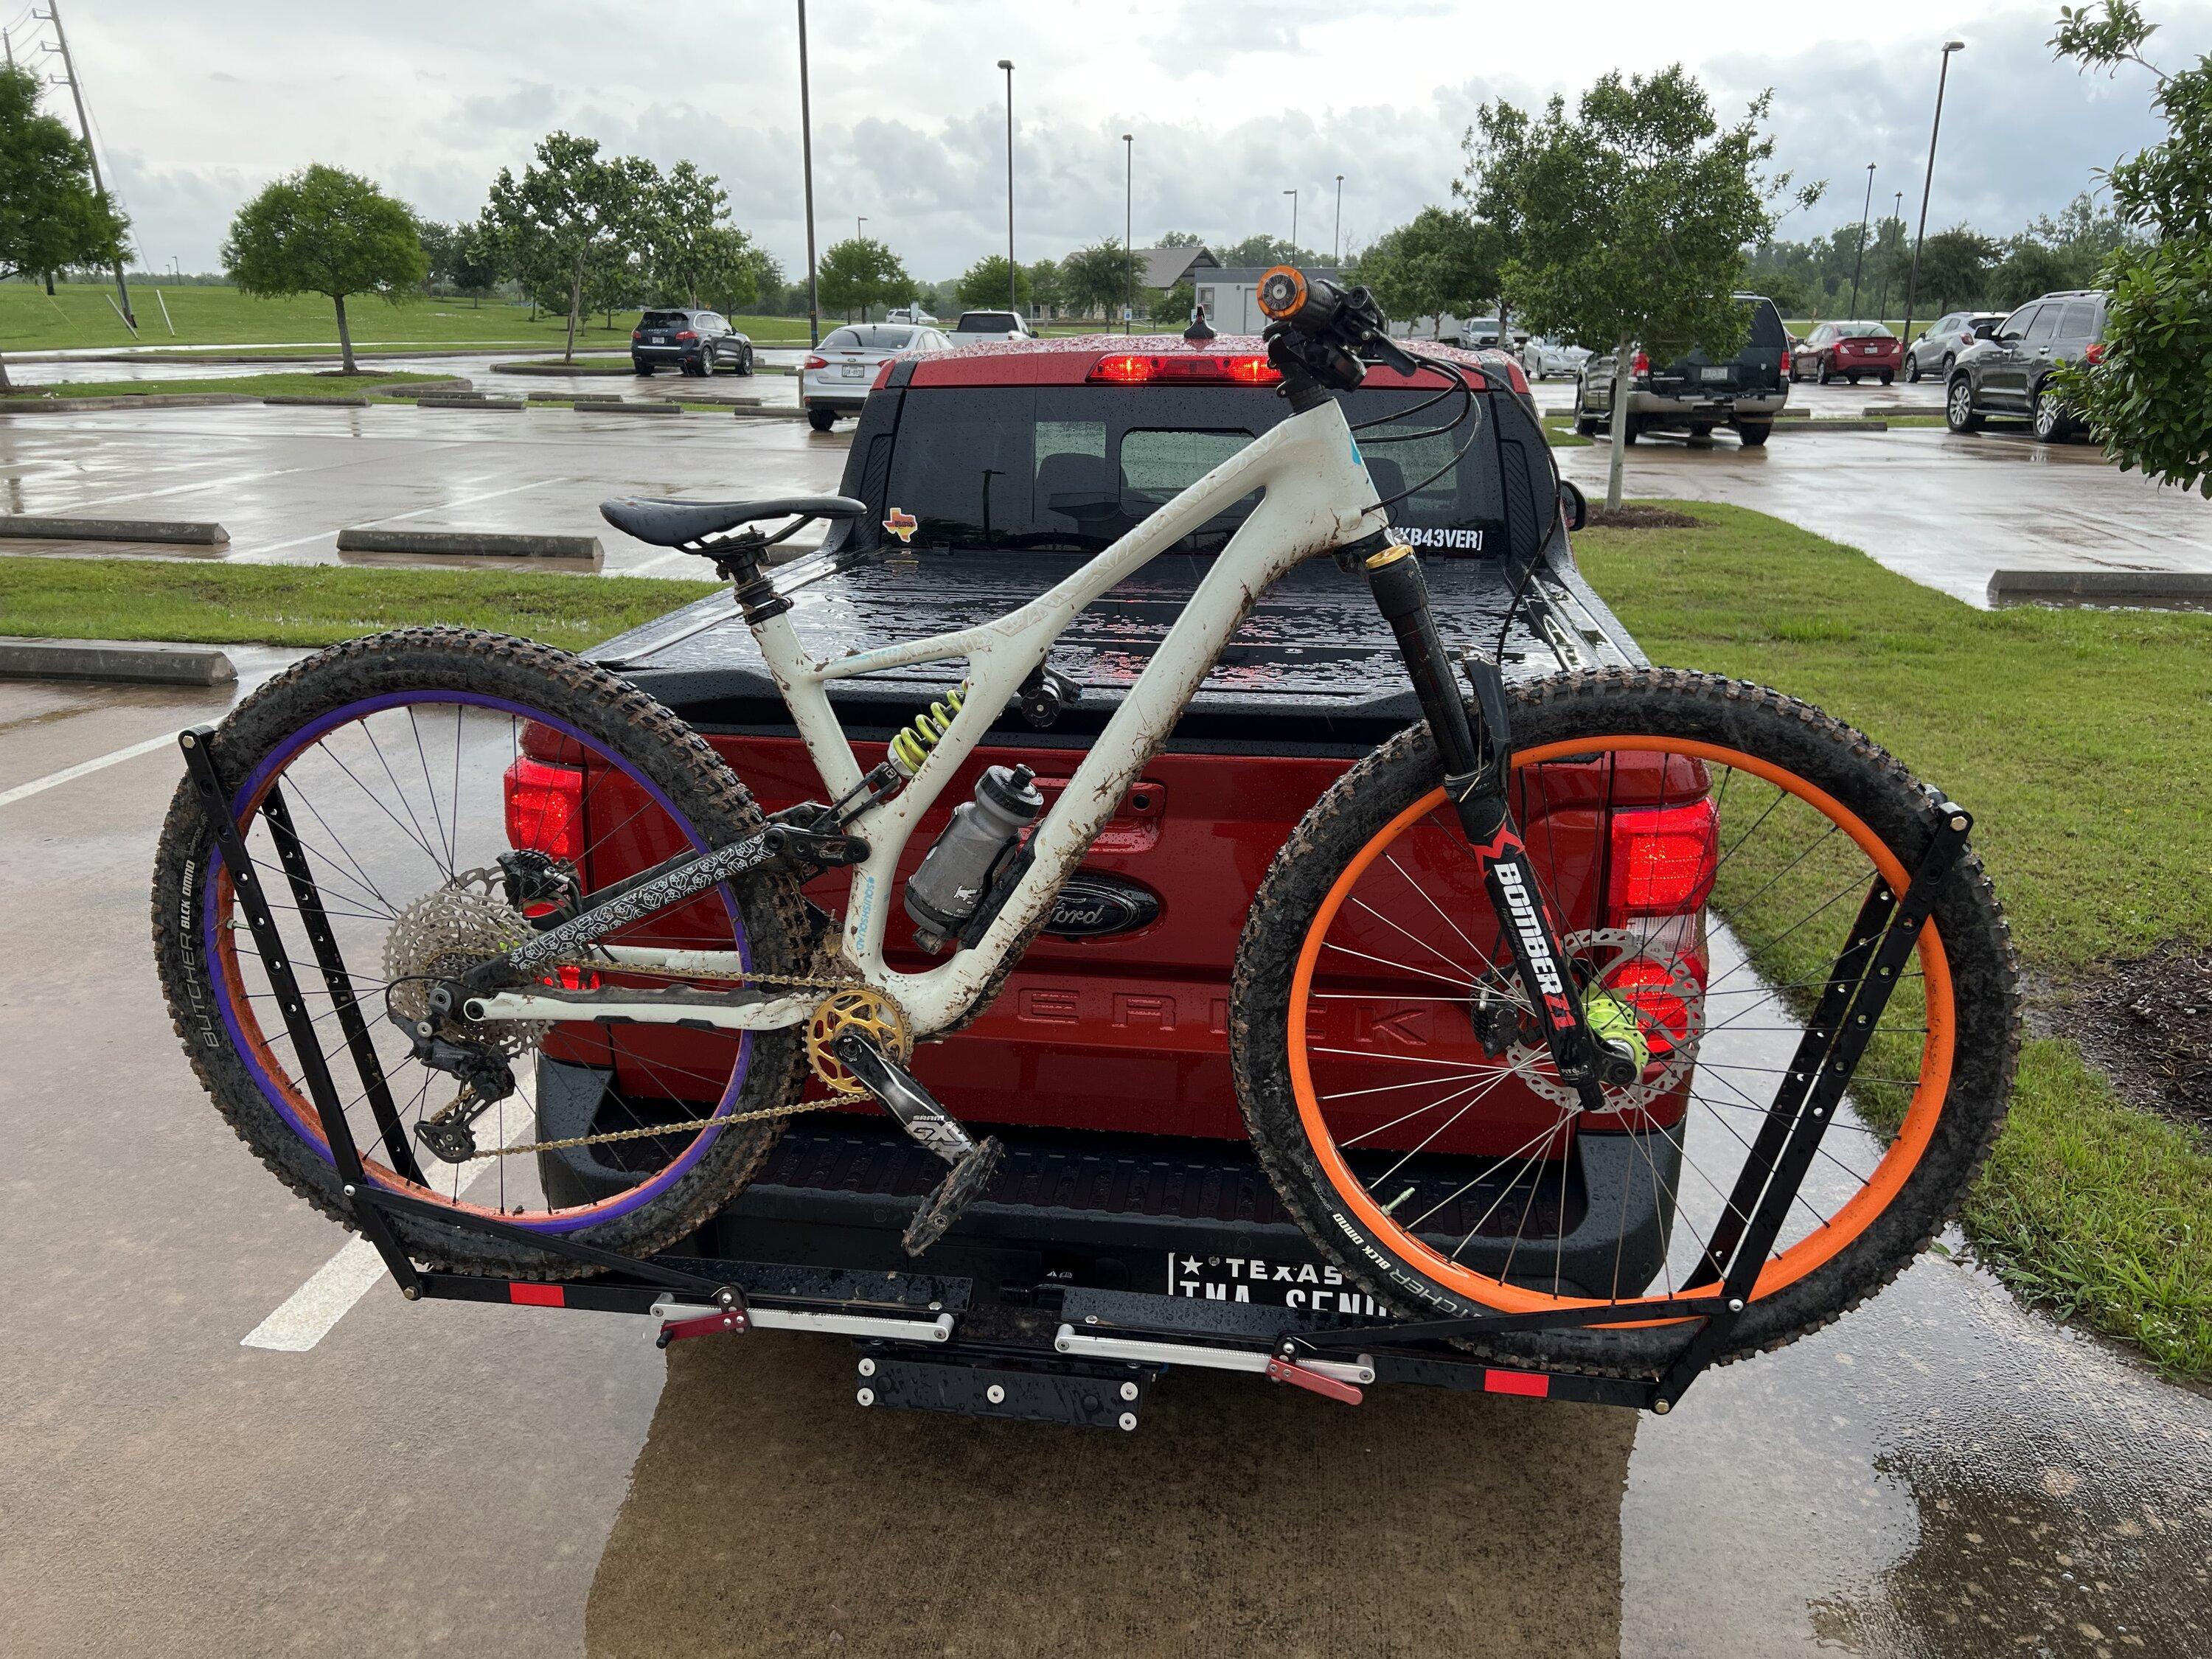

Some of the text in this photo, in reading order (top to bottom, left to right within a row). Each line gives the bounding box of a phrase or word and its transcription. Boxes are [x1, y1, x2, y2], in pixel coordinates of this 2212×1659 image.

[182, 860, 195, 897] DMND
[181, 900, 191, 929] BLCK
[1494, 862, 1563, 995] BOMBER
[180, 932, 219, 1047] BUTCHER
[1332, 1213, 1365, 1245] DMND
[1225, 1258, 1343, 1285] TEXAS
[1362, 1245, 1391, 1270] BLCK
[1389, 1268, 1482, 1318] TCHER
